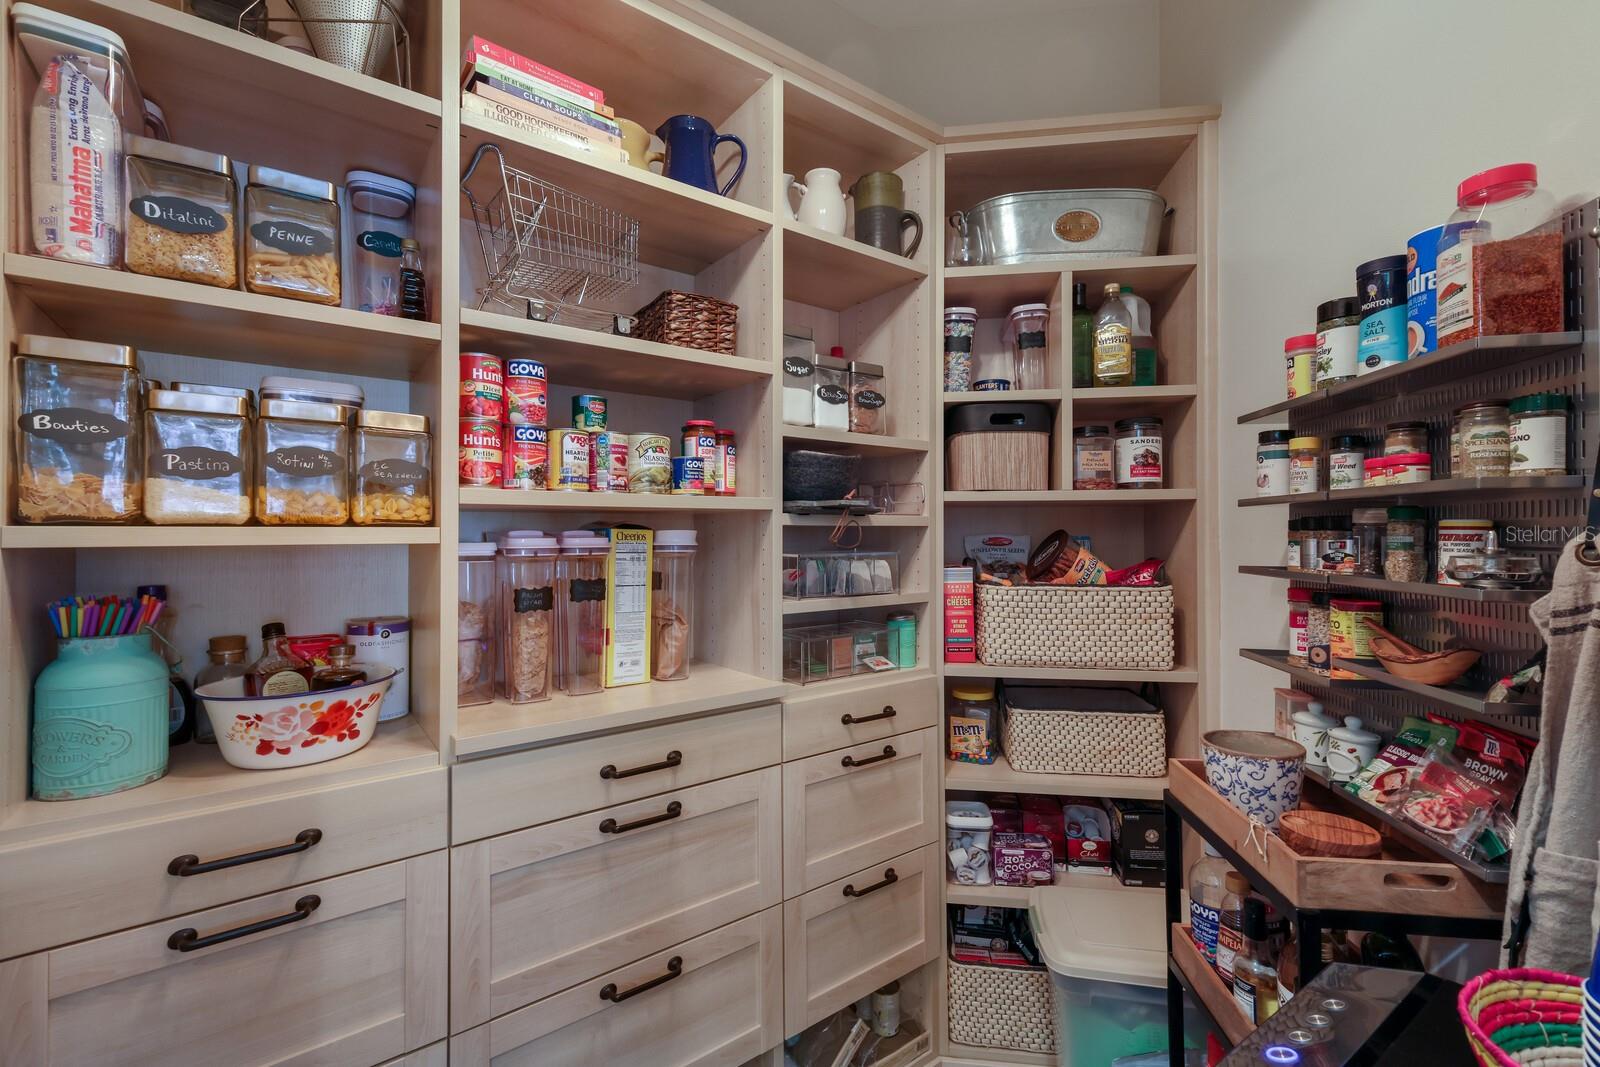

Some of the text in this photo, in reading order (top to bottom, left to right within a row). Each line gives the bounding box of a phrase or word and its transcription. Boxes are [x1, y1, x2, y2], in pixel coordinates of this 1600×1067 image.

[523, 92, 582, 119] CLEAN SOUPS
[68, 118, 78, 140] Extra
[495, 103, 523, 120] GOOD
[524, 114, 589, 144] HOUSEKEEPING
[81, 126, 91, 145] Arroz
[69, 145, 93, 235] Mahatma
[143, 200, 215, 228] Ditalini
[269, 226, 315, 246] PENNE
[1408, 267, 1437, 299] ndra
[1361, 297, 1393, 312] MORTON
[1364, 326, 1386, 337] SALT
[1366, 320, 1384, 330] SEA
[510, 363, 545, 377] GOYA
[786, 360, 810, 374] Sugar
[976, 382, 998, 390] LANTERS
[33, 414, 110, 434] Bowties
[463, 433, 501, 448] Hunt's
[516, 428, 547, 441] GOYA
[162, 453, 230, 472] Pastina
[616, 531, 647, 541] Cheerios
[947, 598, 972, 606] CHEESE
[1386, 745, 1410, 759] CLASSIC
[1464, 758, 1508, 781] BROWN
[1469, 770, 1496, 785] GRAVY
[1004, 855, 1024, 864] HOT
[1004, 861, 1038, 873] COCOA
